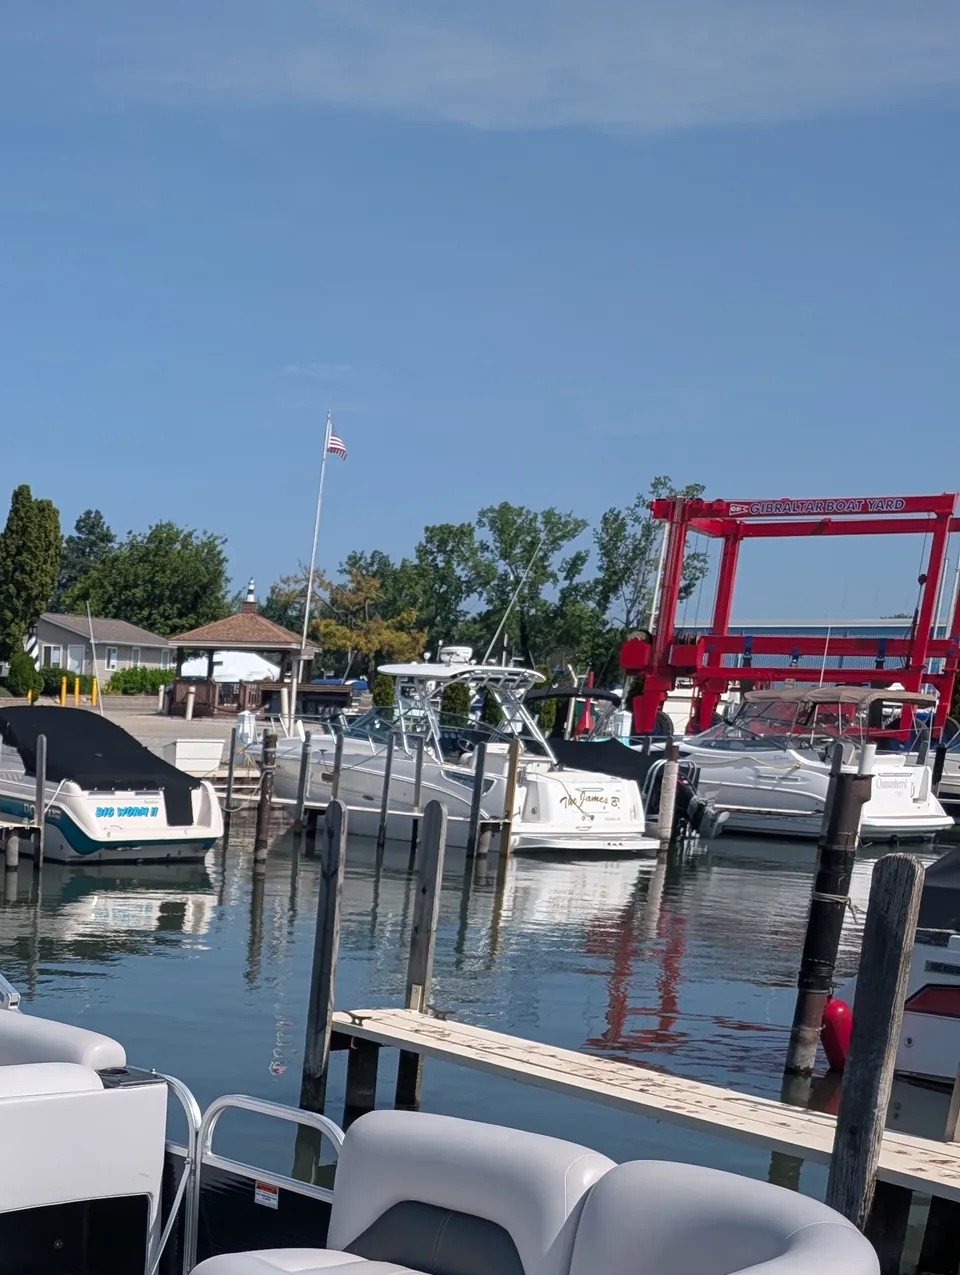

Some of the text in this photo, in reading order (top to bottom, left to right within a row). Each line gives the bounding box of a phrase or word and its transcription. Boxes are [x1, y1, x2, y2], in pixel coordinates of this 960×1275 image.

[749, 498, 906, 514] GIBRALTAR BOAT YARD
[559, 795, 577, 809] The
[579, 791, 608, 807] James
[96, 806, 158, 817] BIG WORM II
